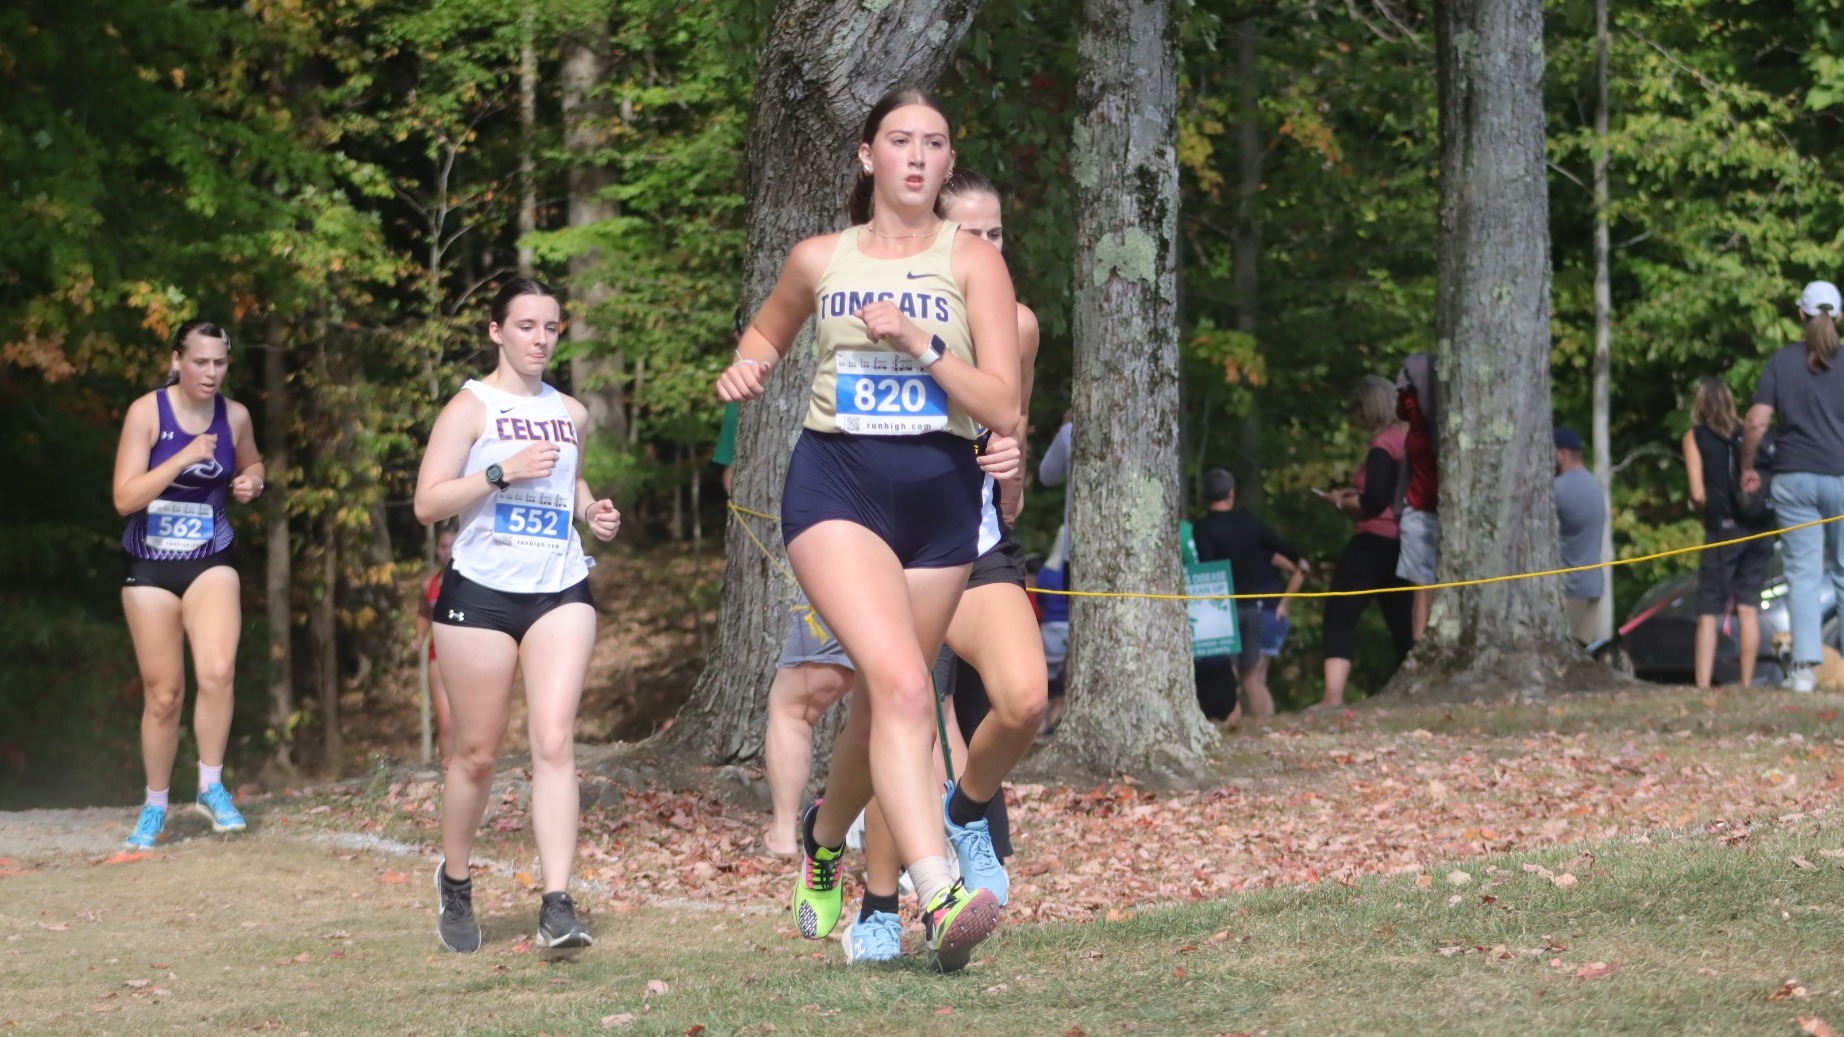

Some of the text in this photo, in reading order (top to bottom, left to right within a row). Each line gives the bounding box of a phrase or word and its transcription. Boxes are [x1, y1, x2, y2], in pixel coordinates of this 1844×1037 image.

[854, 378, 926, 413] 820
[866, 422, 932, 432] runhigh.com
[159, 516, 202, 538] 562
[508, 508, 558, 536] 552
[517, 539, 560, 549] runhigh.com
